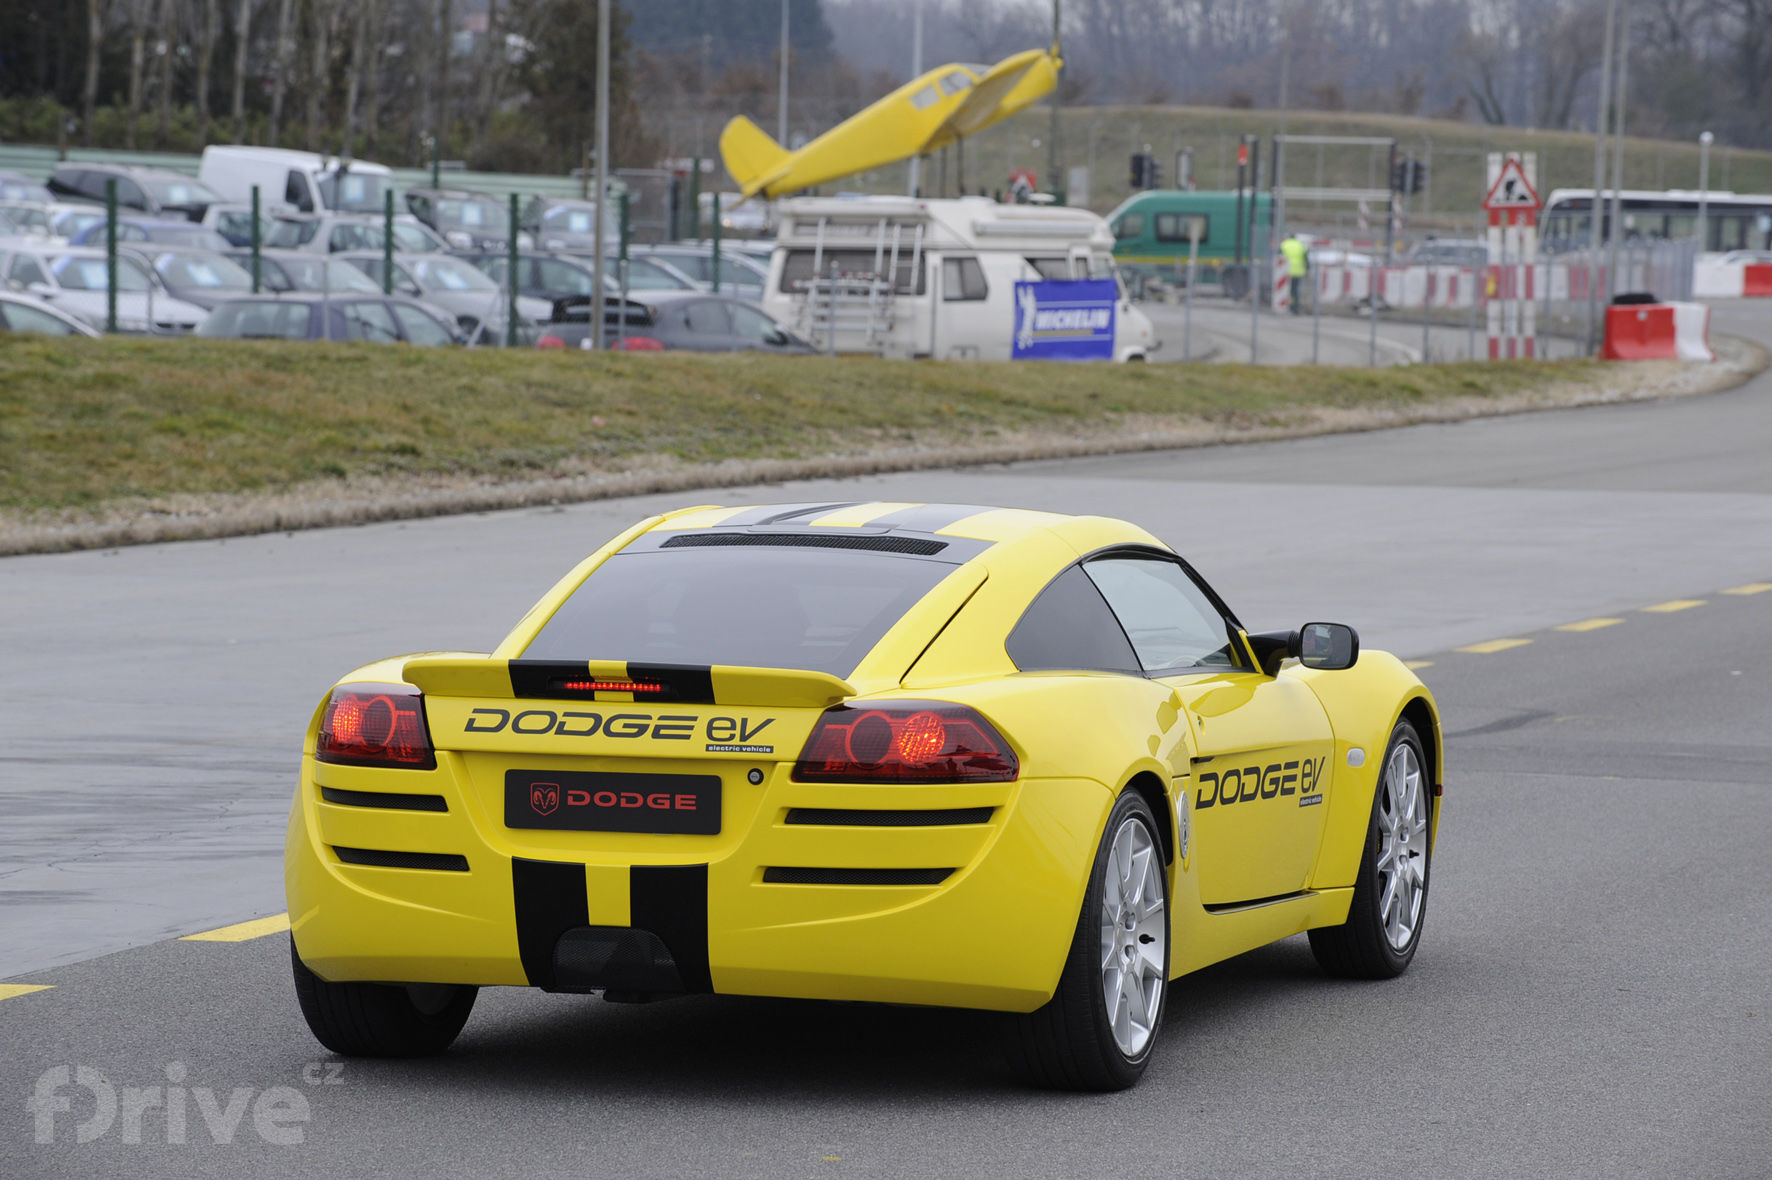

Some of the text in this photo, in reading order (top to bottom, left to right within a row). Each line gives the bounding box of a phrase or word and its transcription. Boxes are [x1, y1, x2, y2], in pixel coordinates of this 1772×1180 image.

[1035, 308, 1111, 330] MICHELIN
[464, 708, 699, 740] DODGE
[1195, 761, 1299, 810] DODGE
[567, 789, 697, 810] DODGE
